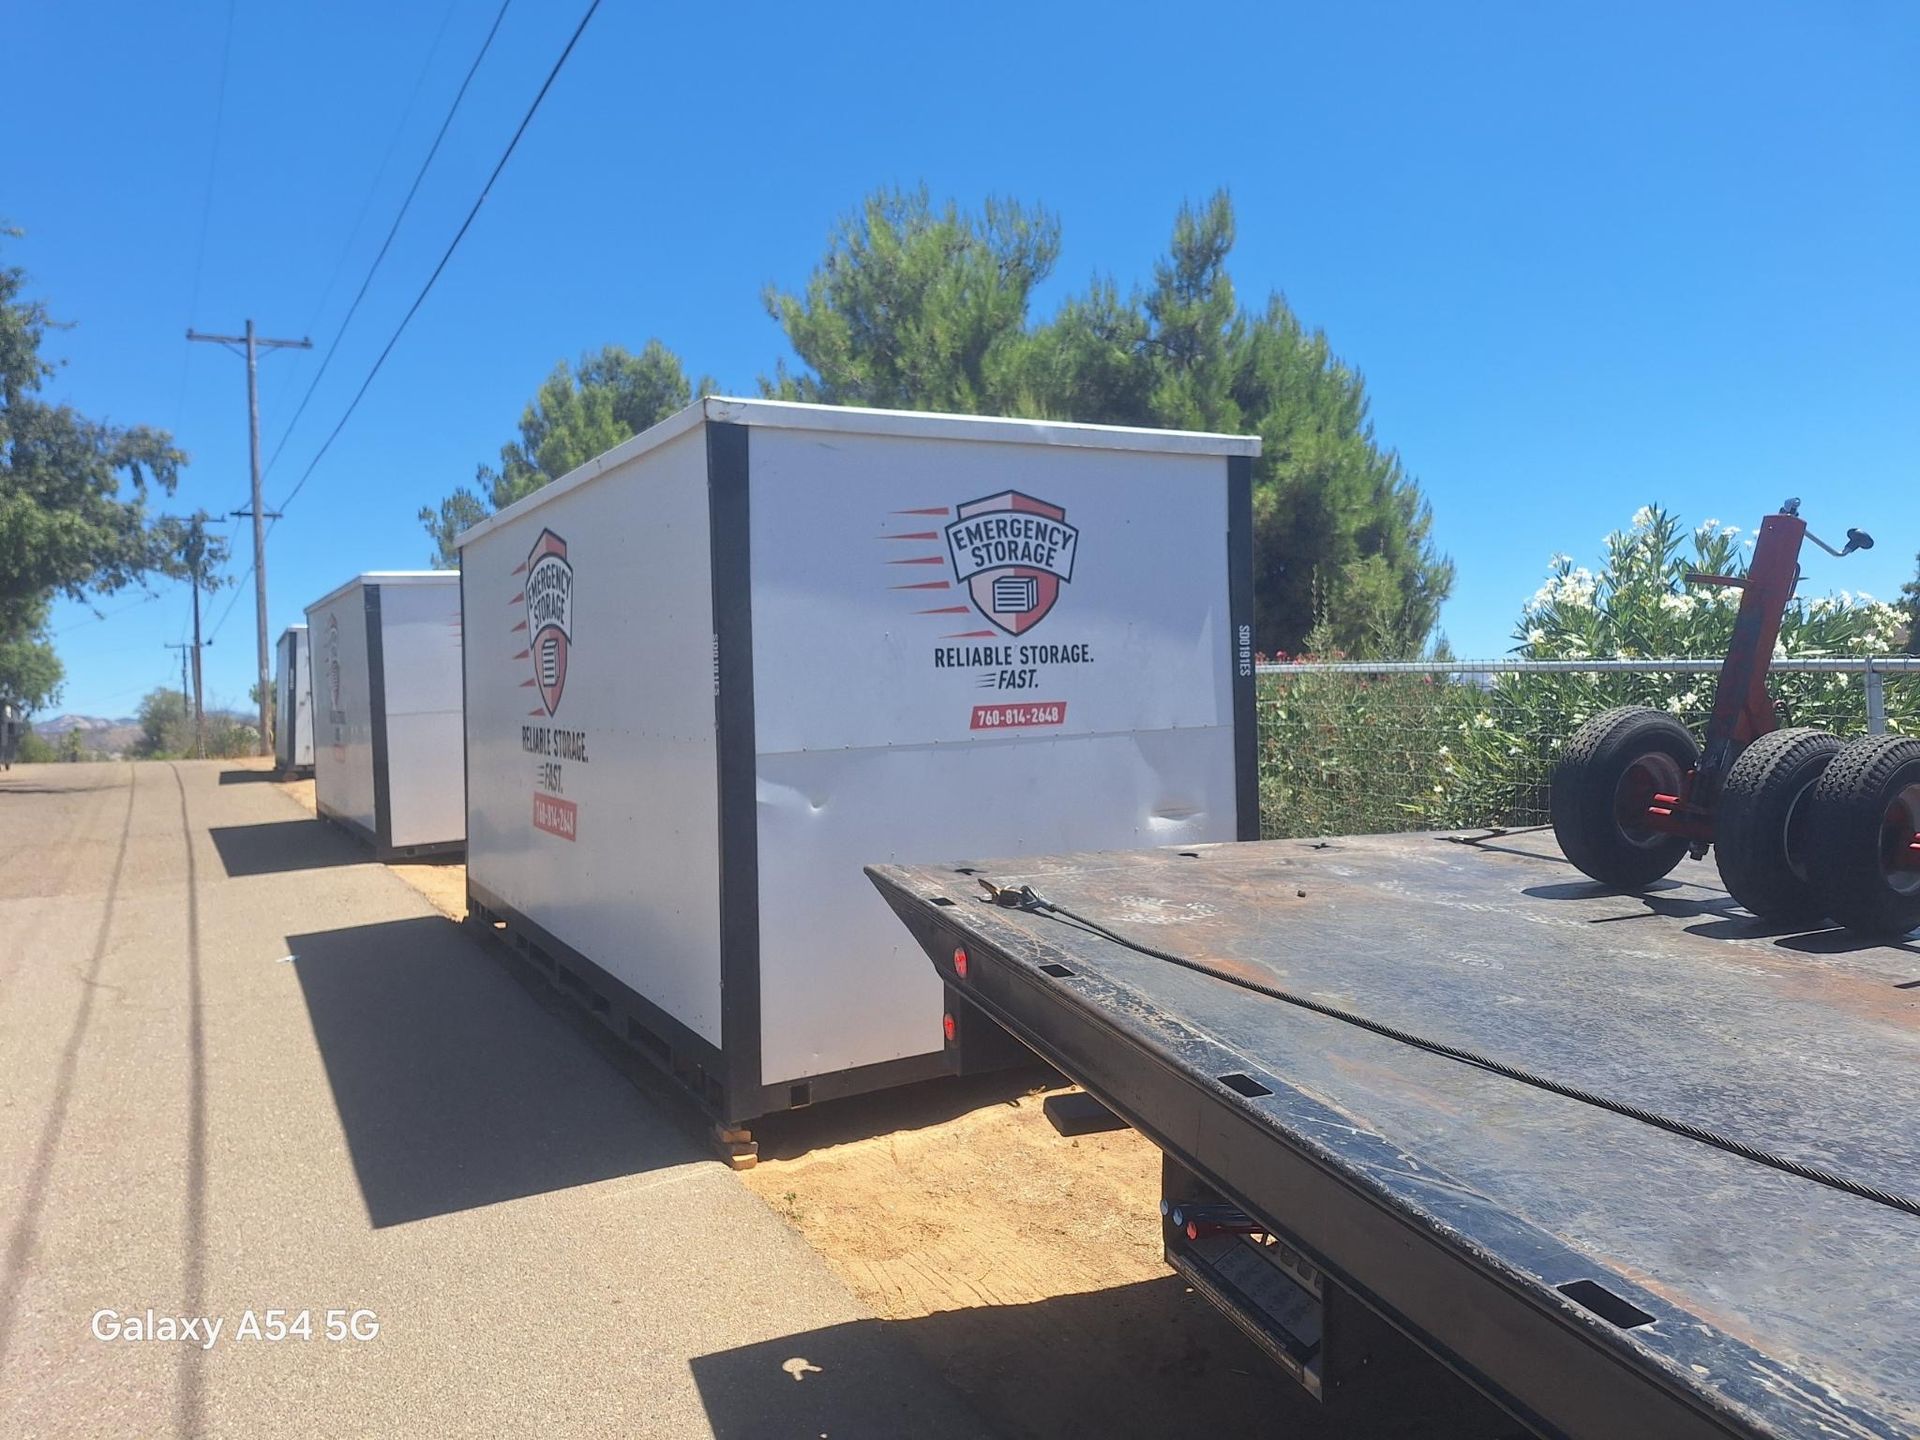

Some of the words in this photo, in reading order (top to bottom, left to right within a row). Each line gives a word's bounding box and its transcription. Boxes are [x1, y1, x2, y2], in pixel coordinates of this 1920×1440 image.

[952, 518, 1073, 551] EMERGENCY
[971, 540, 1057, 567] STORAGE
[528, 563, 571, 610] EMERGENCY
[534, 592, 564, 630] STORAGE
[934, 646, 1012, 668] RELIABLE
[1020, 644, 1094, 665] STORAGE.
[998, 669, 1039, 689] FAST.
[977, 707, 1059, 726] 760-814-2648
[522, 725, 551, 756] RELIABLE
[554, 729, 589, 763] STORAGE.
[545, 762, 563, 794] FAST.
